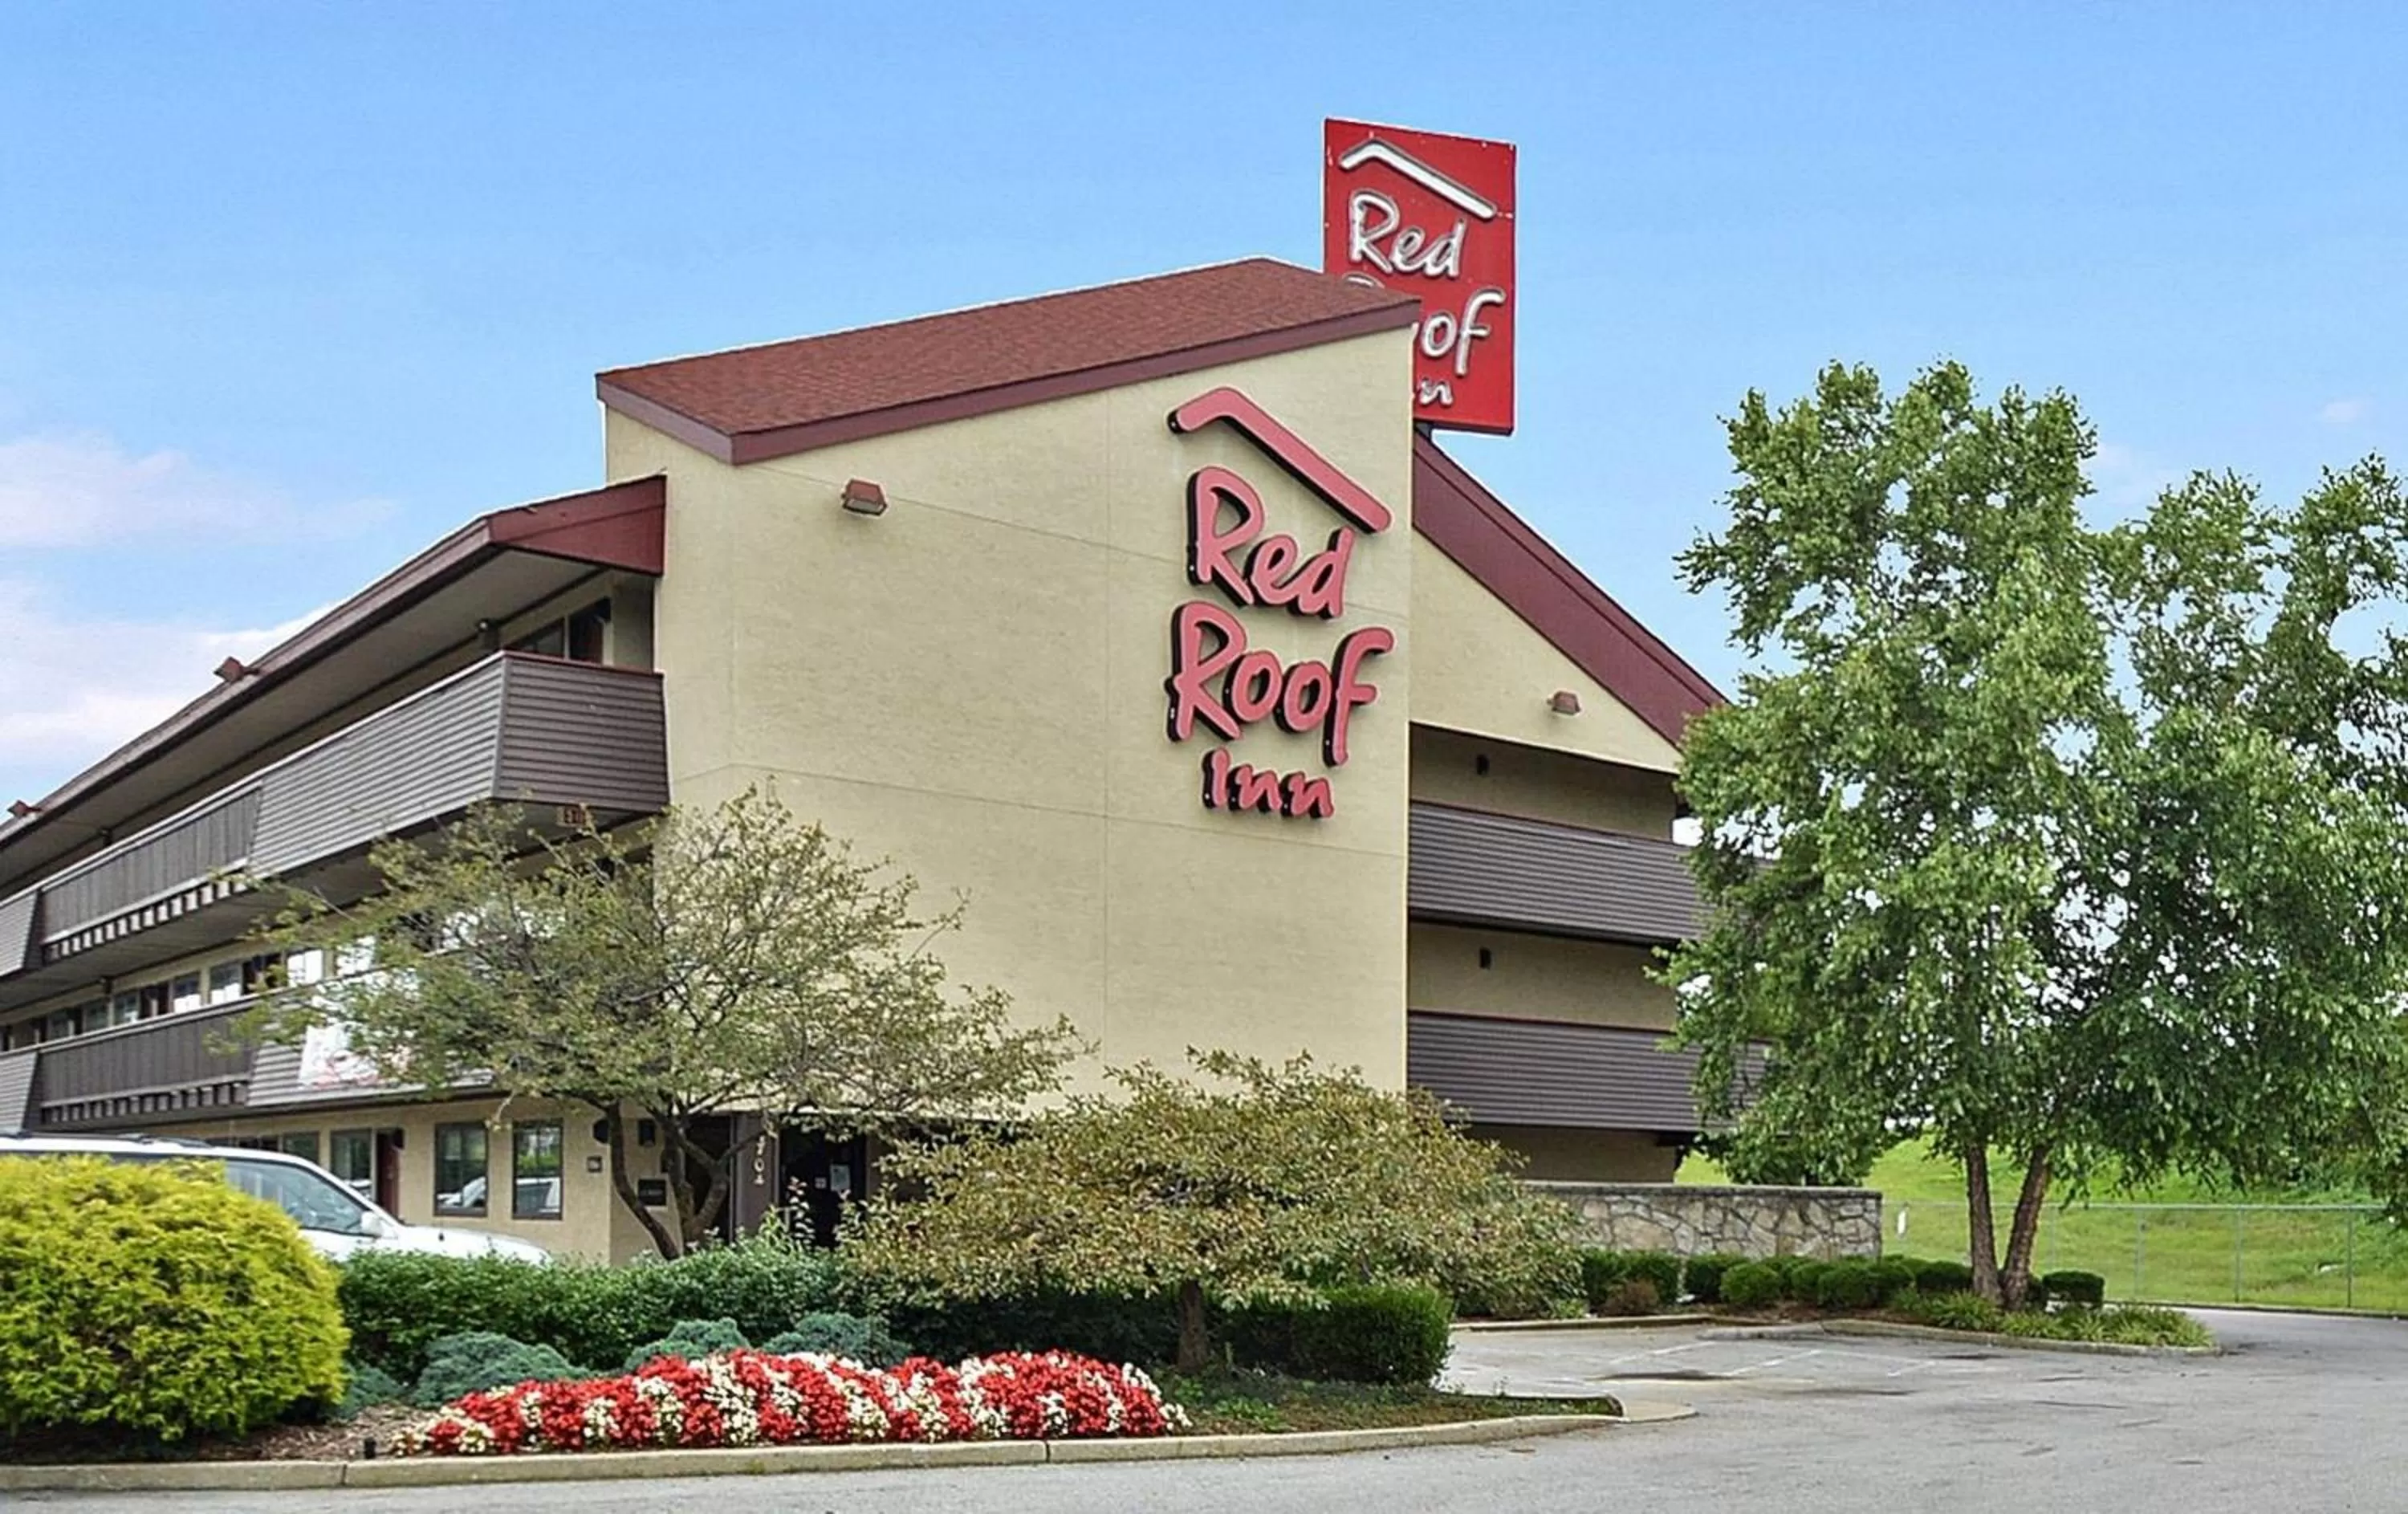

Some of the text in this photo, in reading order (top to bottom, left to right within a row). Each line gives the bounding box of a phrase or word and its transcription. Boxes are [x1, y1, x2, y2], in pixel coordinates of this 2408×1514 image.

[1349, 188, 1466, 277] Red
[1186, 466, 1355, 618] Red
[1165, 600, 1394, 766] Roof
[1202, 746, 1334, 818] Inn
